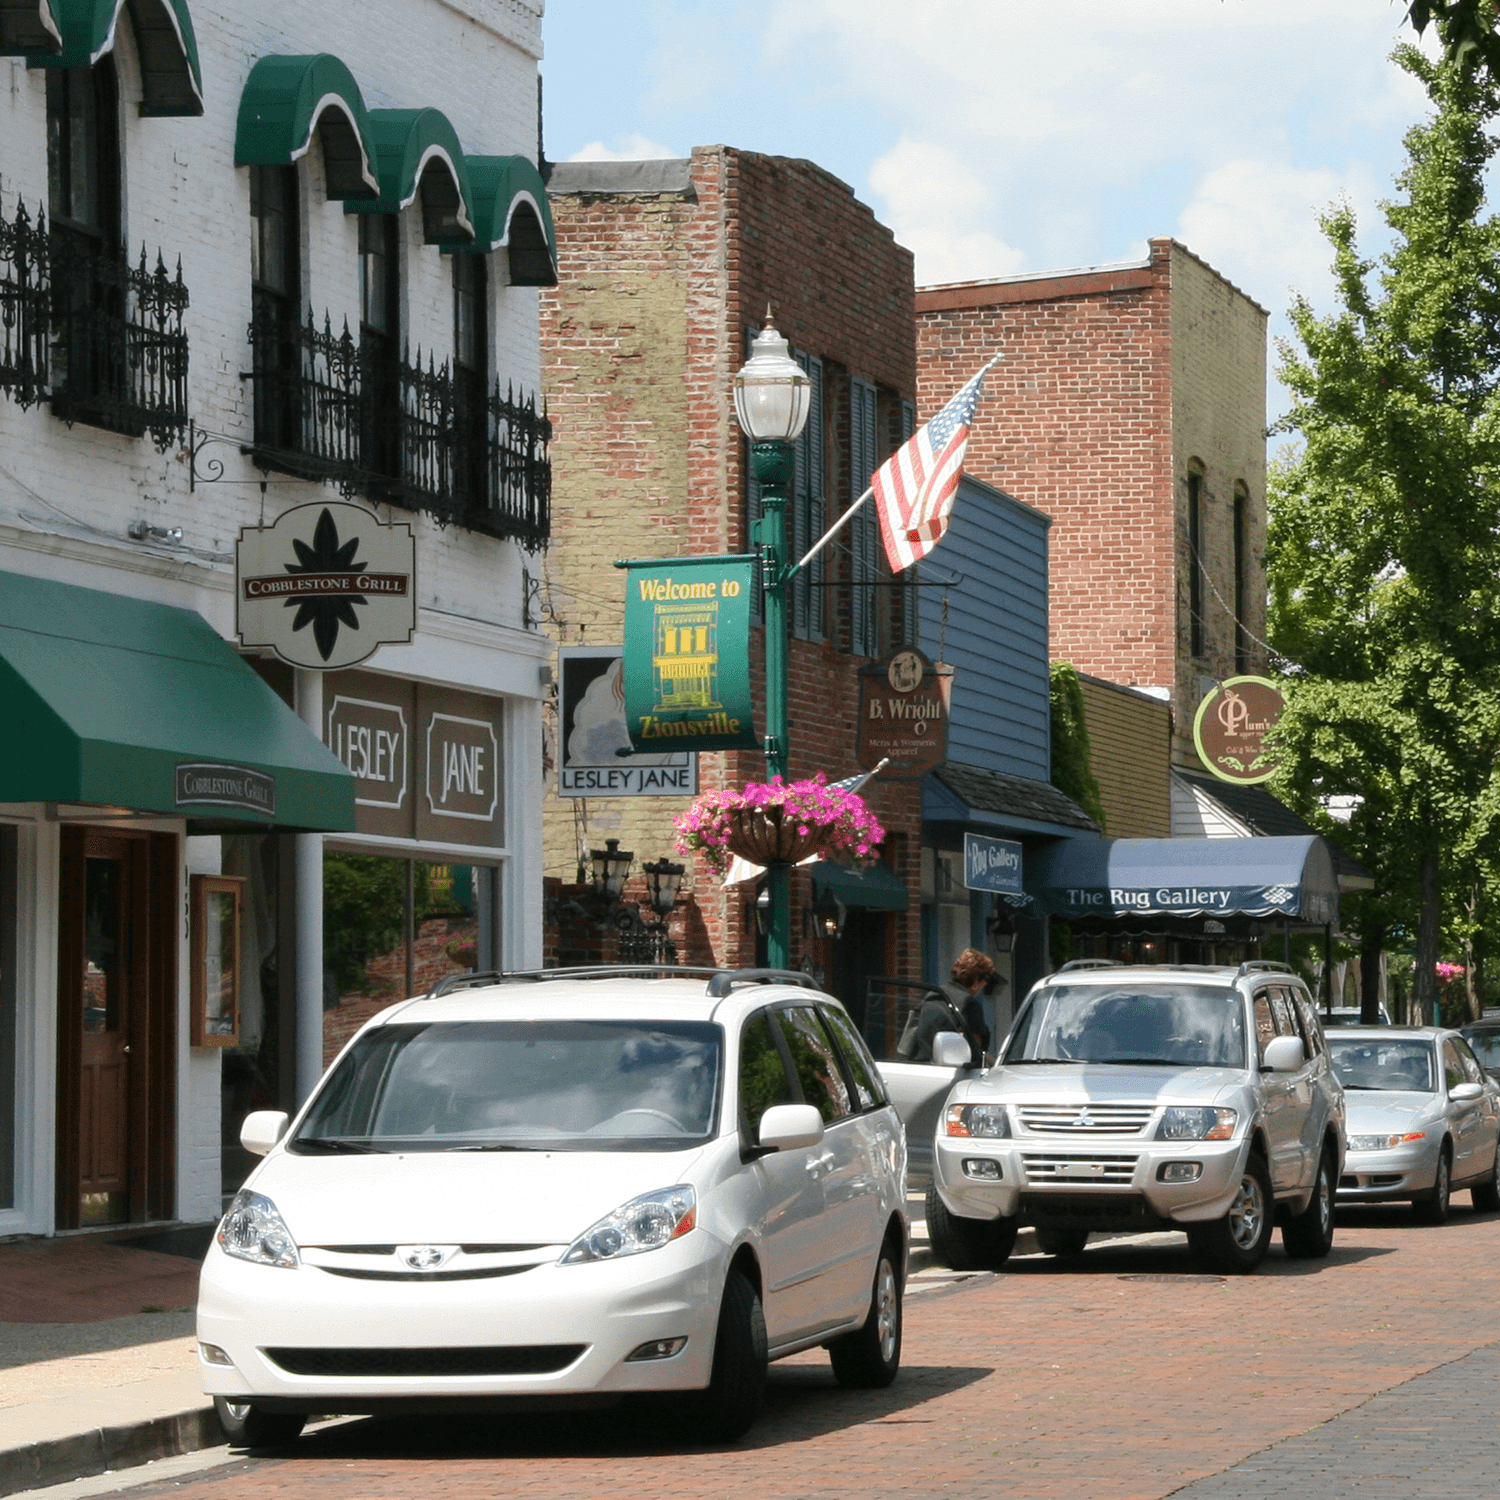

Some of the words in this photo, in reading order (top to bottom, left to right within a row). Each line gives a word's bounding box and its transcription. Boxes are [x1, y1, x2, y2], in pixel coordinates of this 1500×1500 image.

[355, 575, 402, 592] GRILL
[638, 578, 717, 601] Welcome
[720, 578, 742, 598] to
[638, 711, 742, 739] Zionsville
[869, 698, 884, 719] B.
[888, 695, 941, 736] Wright
[336, 722, 400, 783] LESLEY
[440, 740, 485, 804] JANE
[561, 769, 633, 790] LESLEY
[637, 768, 690, 793] JANE
[988, 846, 1020, 871] Gallery
[1066, 888, 1104, 905] The
[1109, 888, 1151, 909] Rug
[1155, 887, 1232, 909] Gallery
